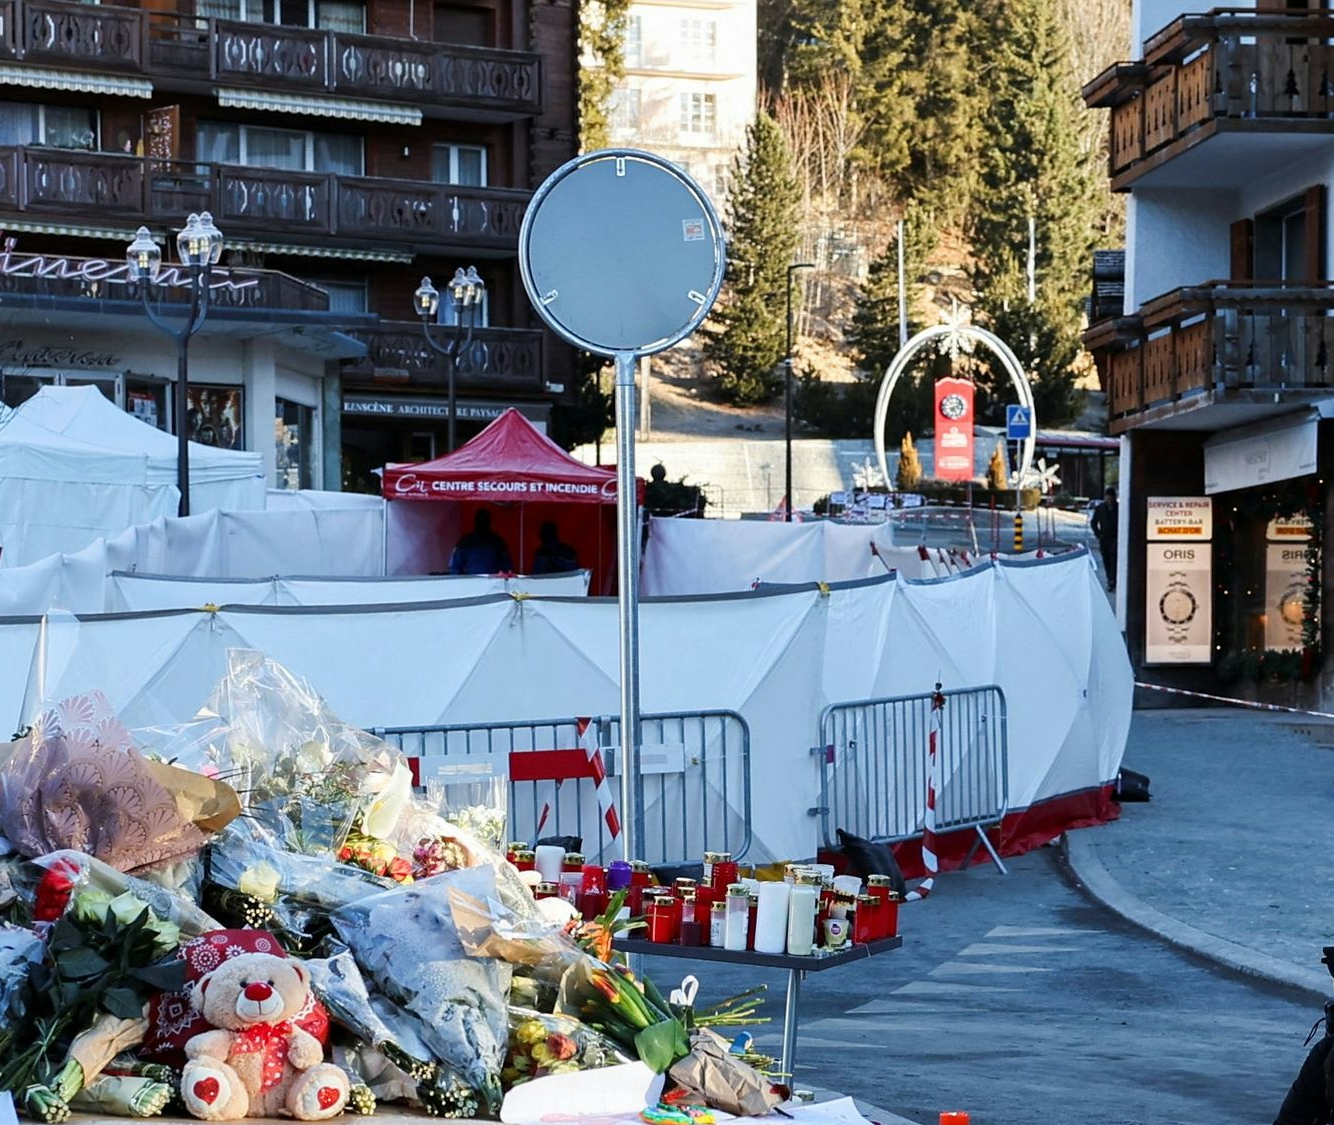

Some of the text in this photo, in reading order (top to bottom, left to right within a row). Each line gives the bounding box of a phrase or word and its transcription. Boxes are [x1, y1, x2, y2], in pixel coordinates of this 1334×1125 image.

[398, 404, 467, 417] ARCHITECTRE
[432, 480, 475, 492] CENTRE
[477, 481, 527, 493] SECOURS
[530, 482, 541, 492] ET
[545, 482, 598, 495] INCENDIE
[1148, 501, 1177, 509] SERVICE
[1163, 549, 1195, 560] ORIS
